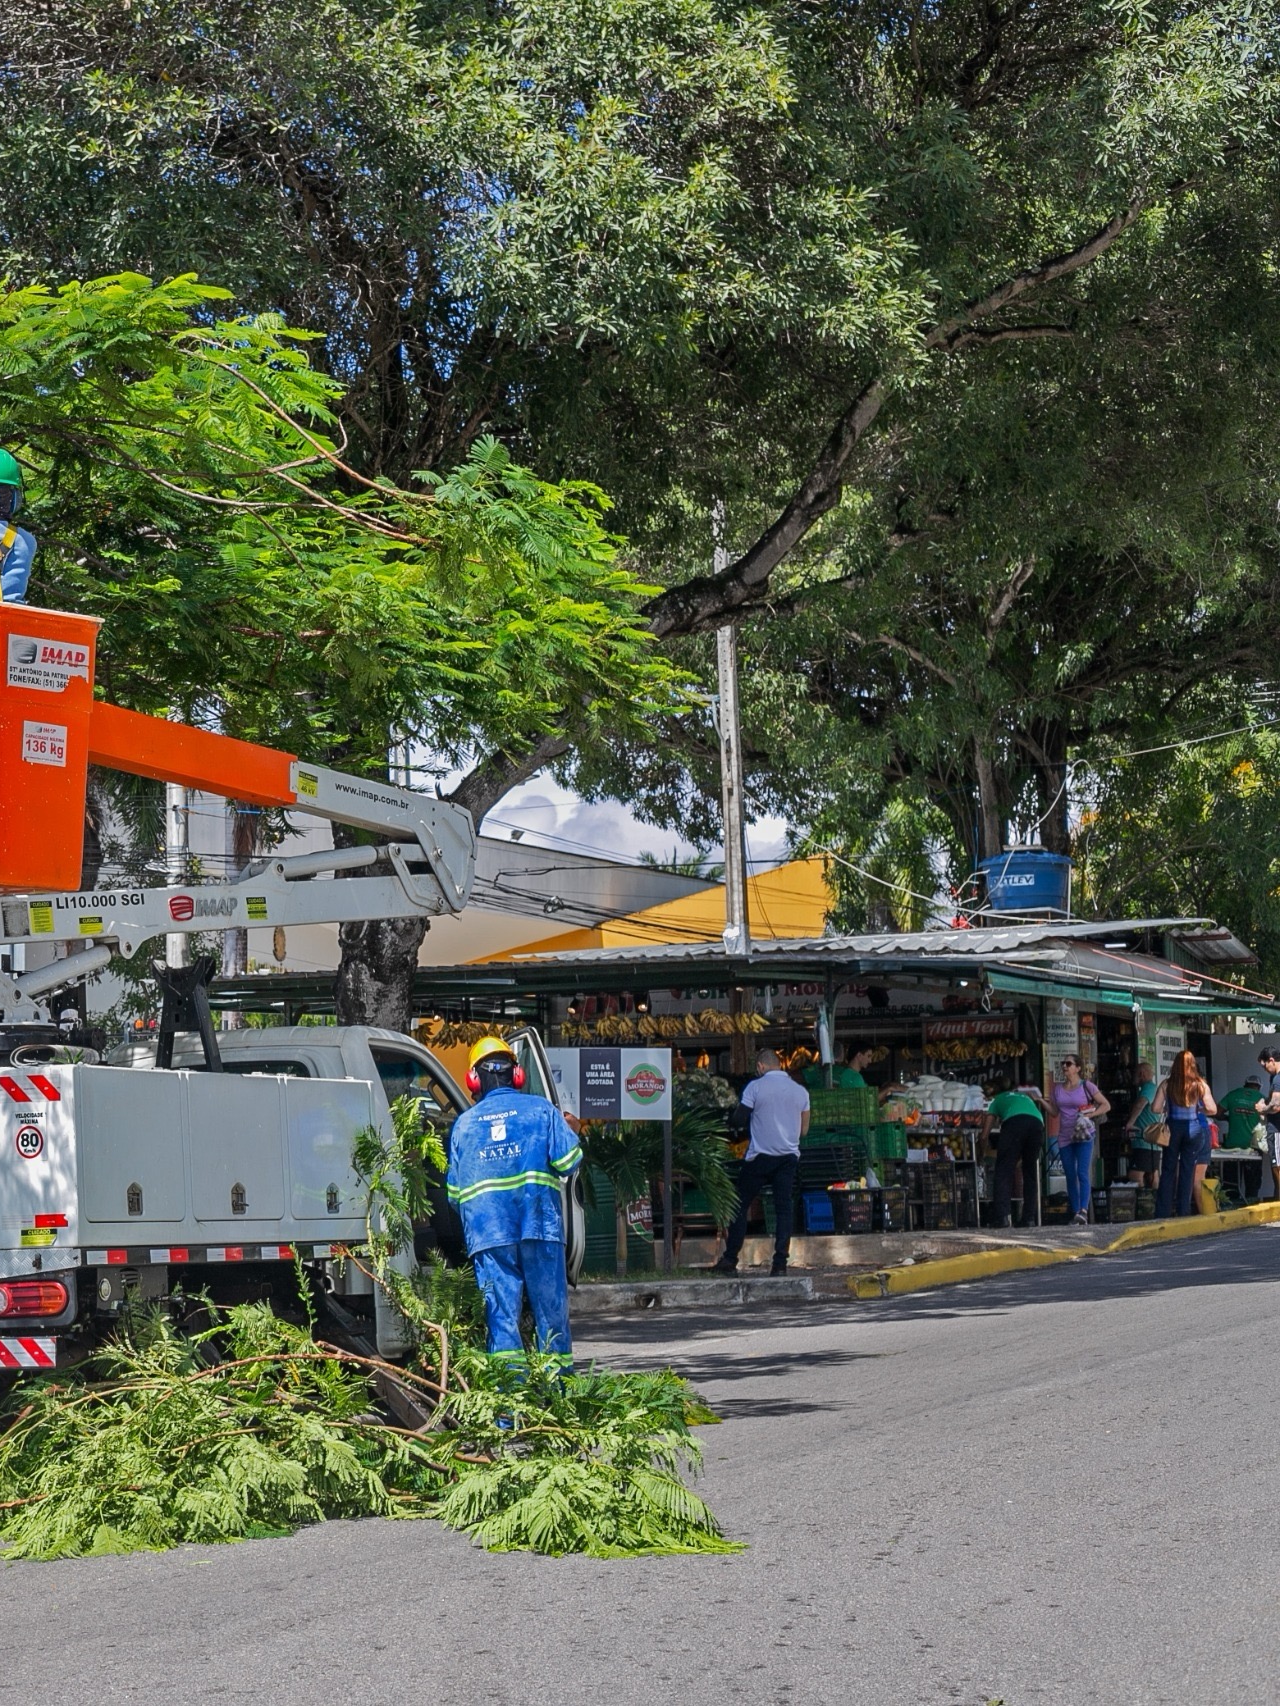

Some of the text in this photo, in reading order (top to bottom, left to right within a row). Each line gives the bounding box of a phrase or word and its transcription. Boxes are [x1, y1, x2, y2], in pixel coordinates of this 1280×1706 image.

[41, 646, 86, 668] IMAP
[19, 667, 43, 677] ANTÔNIO
[9, 674, 42, 686] FONE/FAX:
[43, 678, 55, 688] (51)
[25, 739, 64, 759] 136 kg
[335, 782, 410, 810] www.imap.com.br
[56, 892, 145, 910] LI10.000 SGI
[195, 897, 239, 917] IMAP
[928, 1020, 1013, 1038] Aqui Tem!
[591, 1062, 611, 1071] ESTA É
[587, 1078, 614, 1086] ADOTADA
[627, 1083, 665, 1091] MORANGO
[483, 1112, 509, 1121] SERVIÇO
[20, 1133, 39, 1147] 80
[479, 1144, 522, 1159] NATAL
